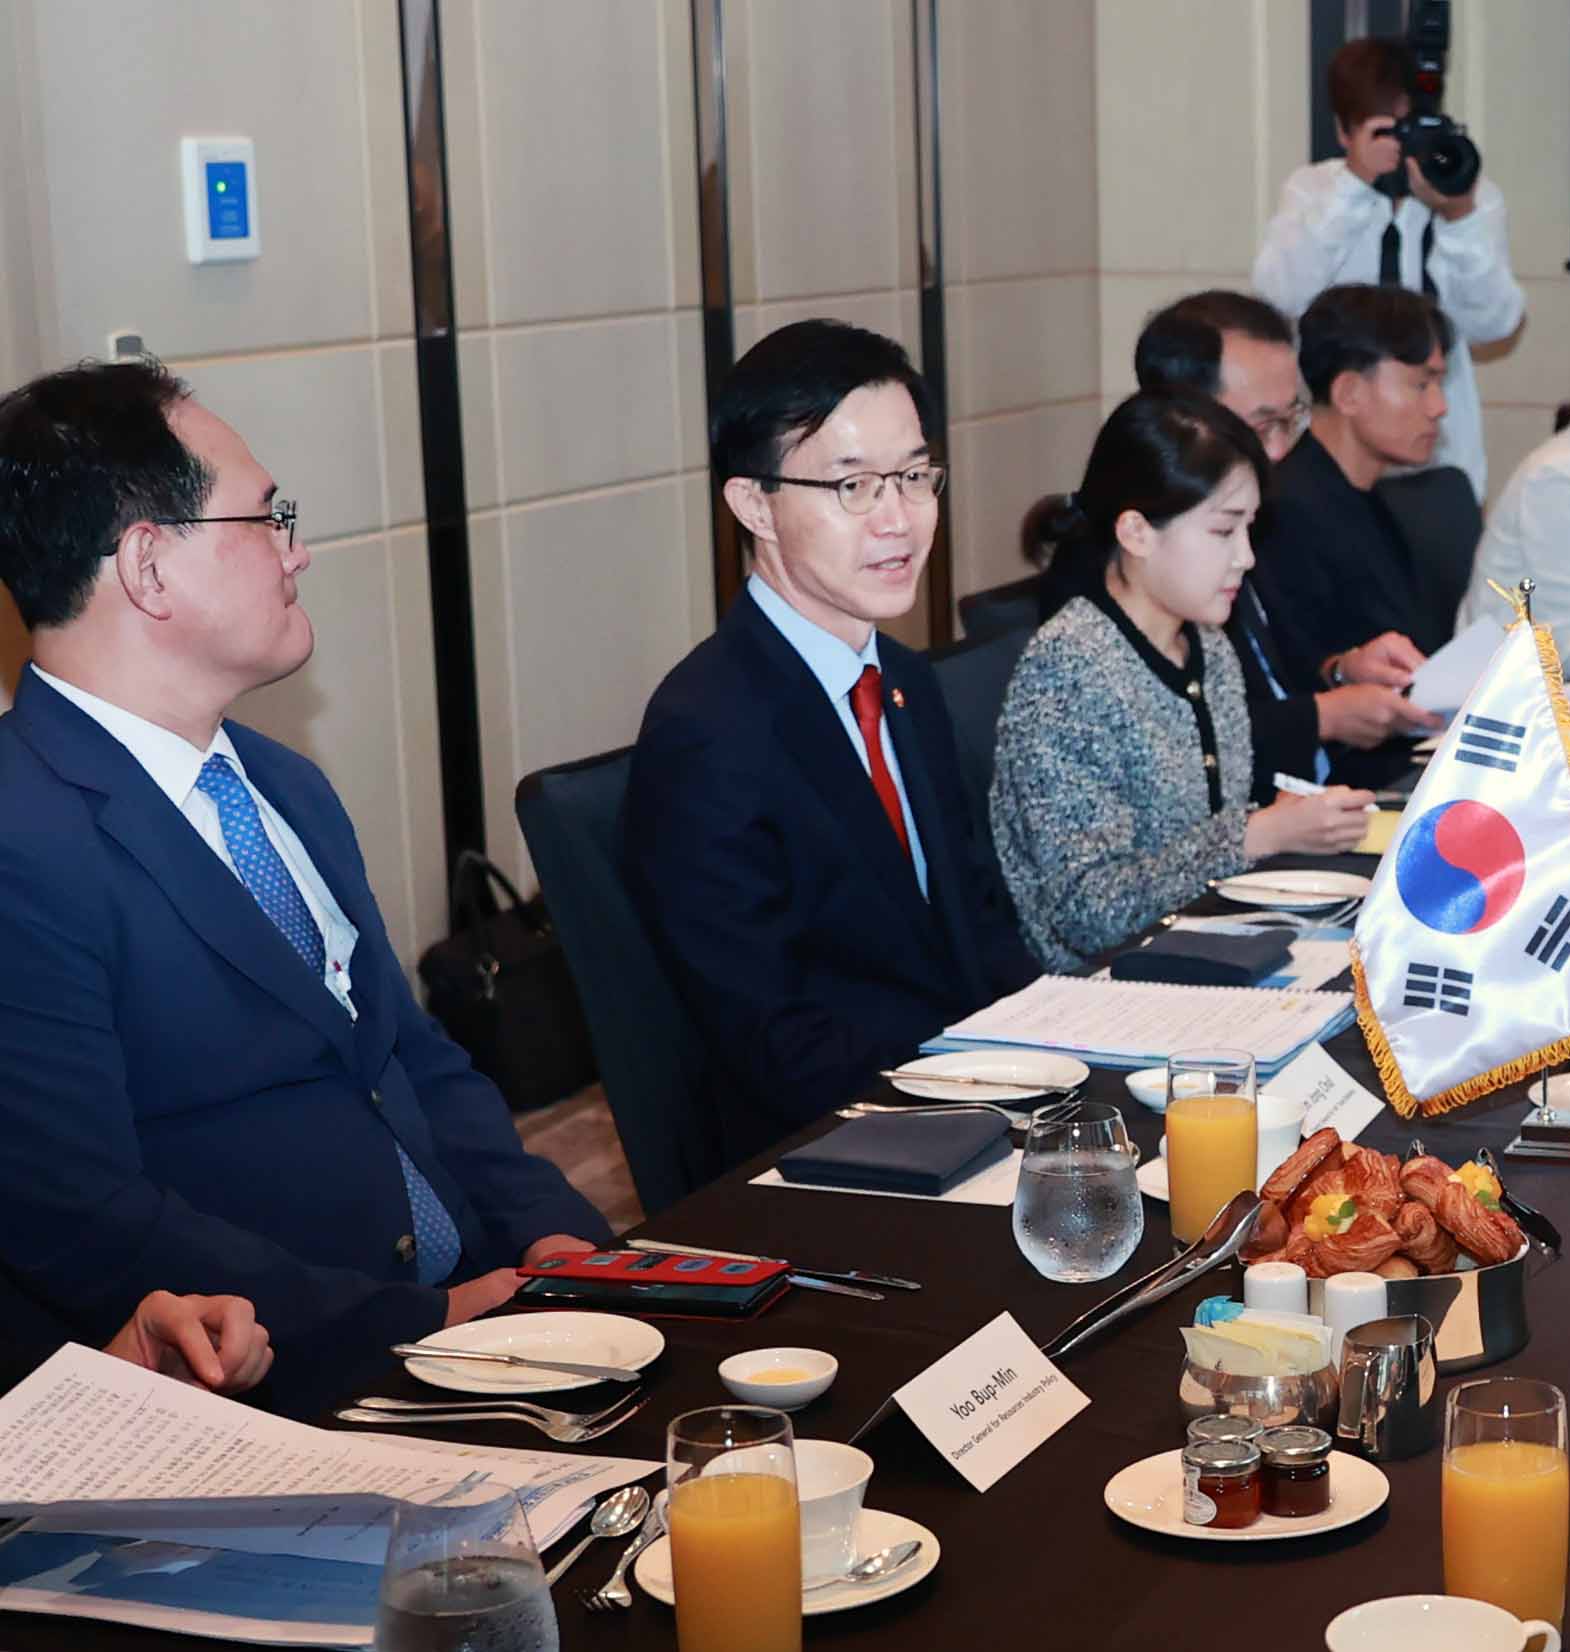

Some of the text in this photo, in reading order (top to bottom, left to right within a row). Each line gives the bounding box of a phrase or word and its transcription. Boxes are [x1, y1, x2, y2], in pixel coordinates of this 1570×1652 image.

[950, 1367, 1018, 1421] Yoo Bup-Min
[950, 1373, 1058, 1460] Director General for Resources Industry Policy
